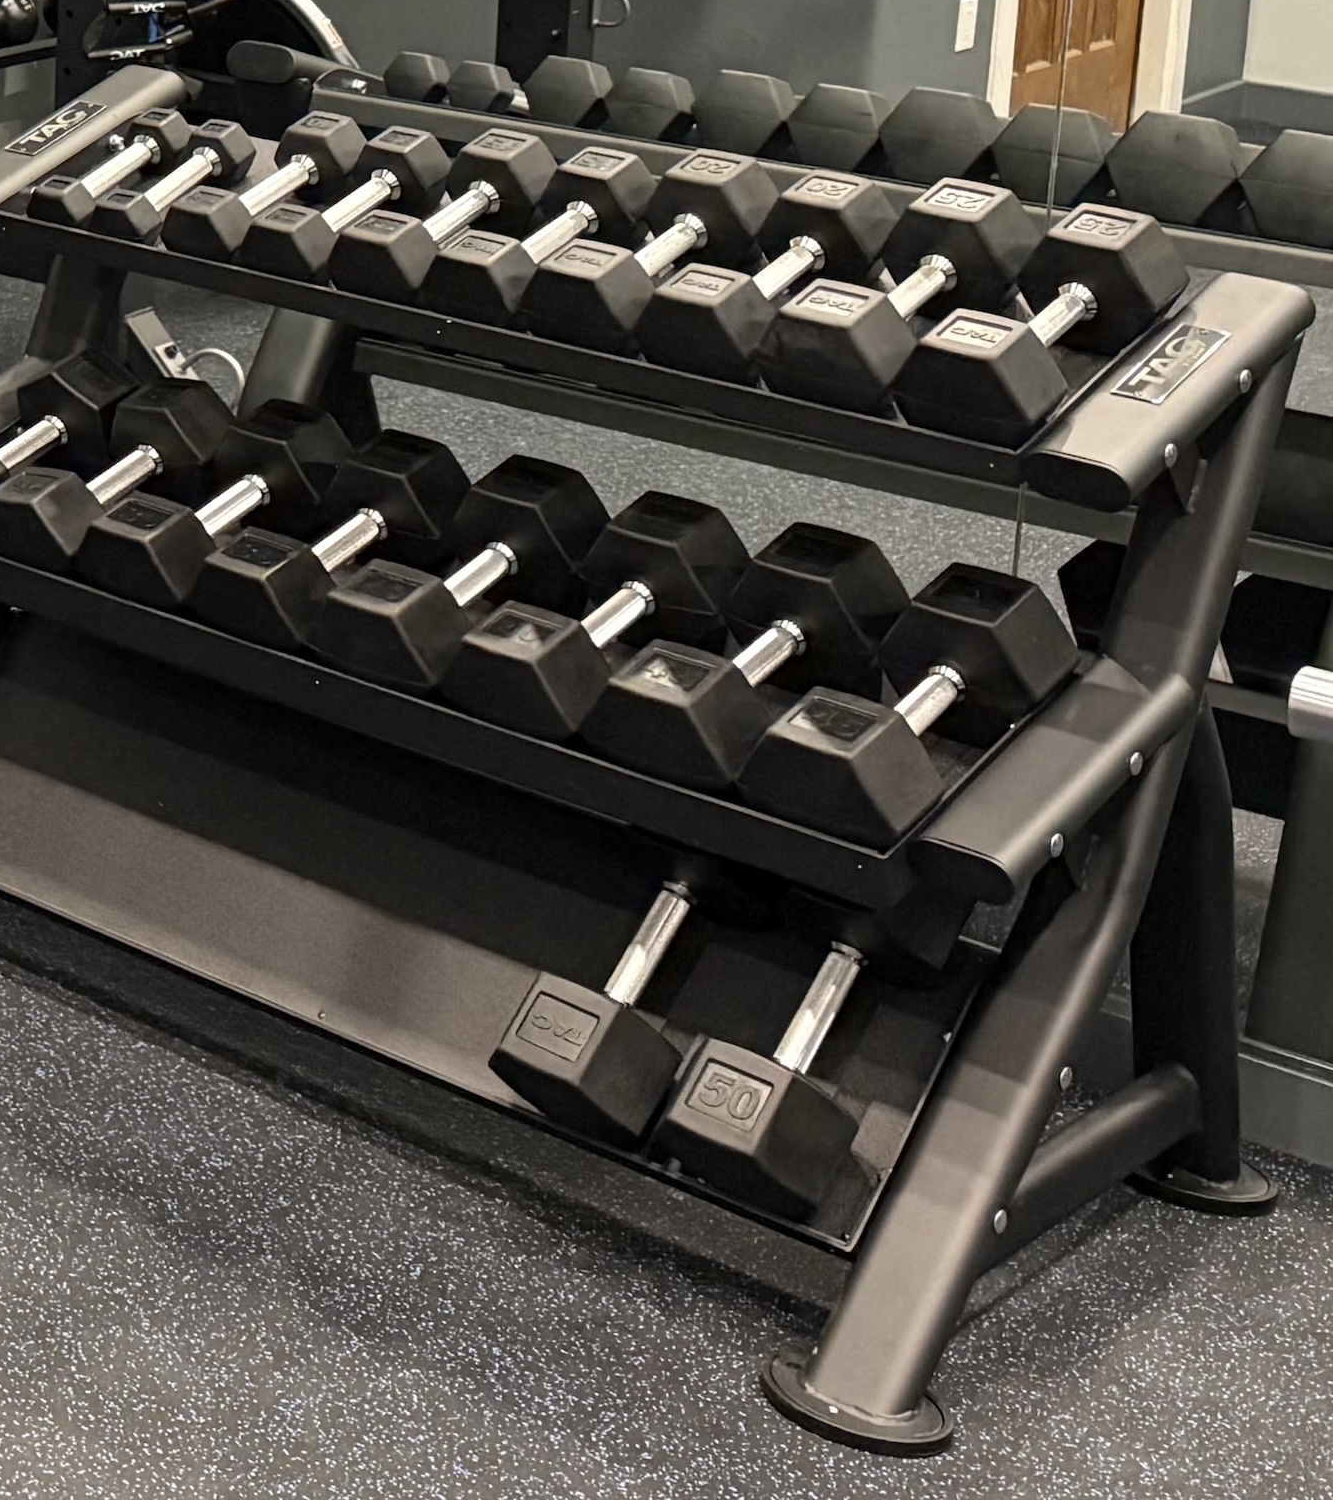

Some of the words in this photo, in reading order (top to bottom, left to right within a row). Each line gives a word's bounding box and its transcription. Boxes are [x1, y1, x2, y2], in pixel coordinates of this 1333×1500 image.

[20, 108, 87, 144] TAG
[934, 192, 986, 209] 25
[1073, 218, 1128, 236] 25
[1127, 336, 1208, 386] TAG
[698, 1071, 761, 1121] 50
